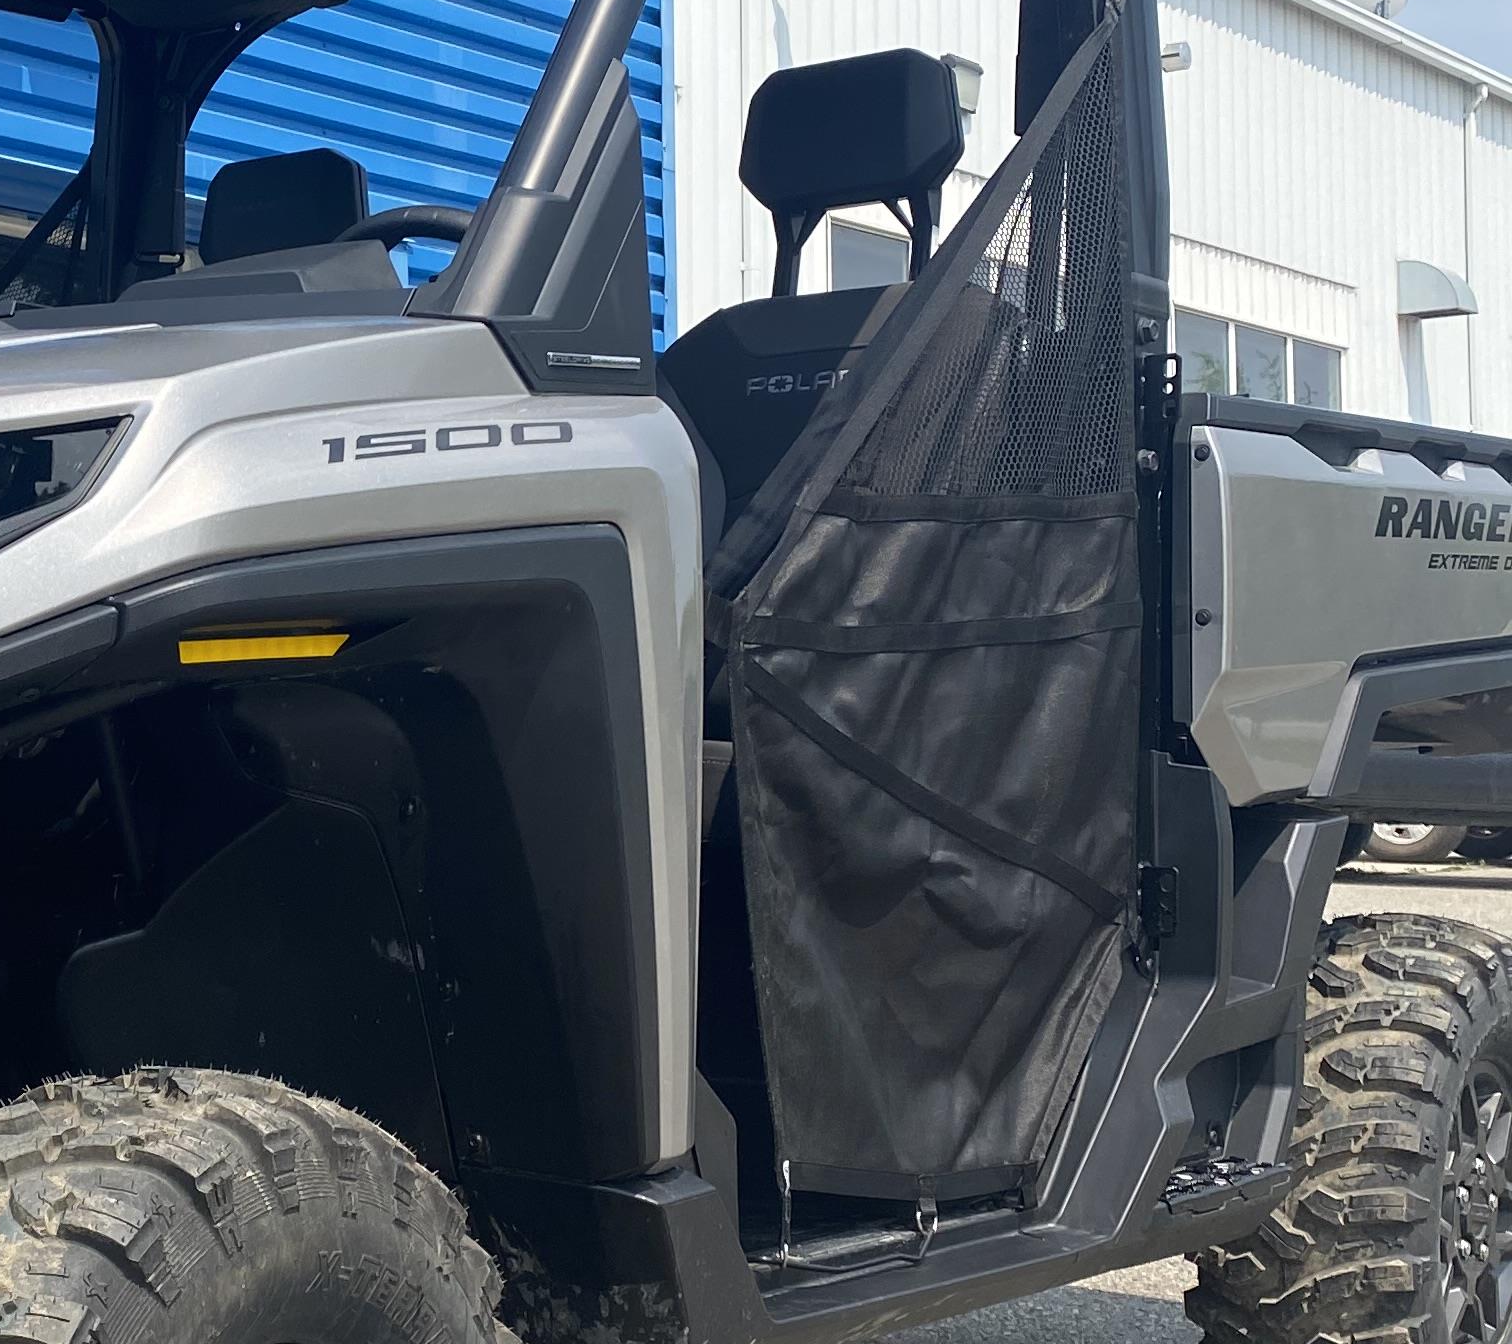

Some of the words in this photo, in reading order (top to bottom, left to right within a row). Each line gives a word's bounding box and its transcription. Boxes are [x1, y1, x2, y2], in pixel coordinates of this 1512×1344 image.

[322, 422, 573, 464] 1500
[1375, 496, 1512, 543] RANGE
[1428, 554, 1499, 570] EXTREME
